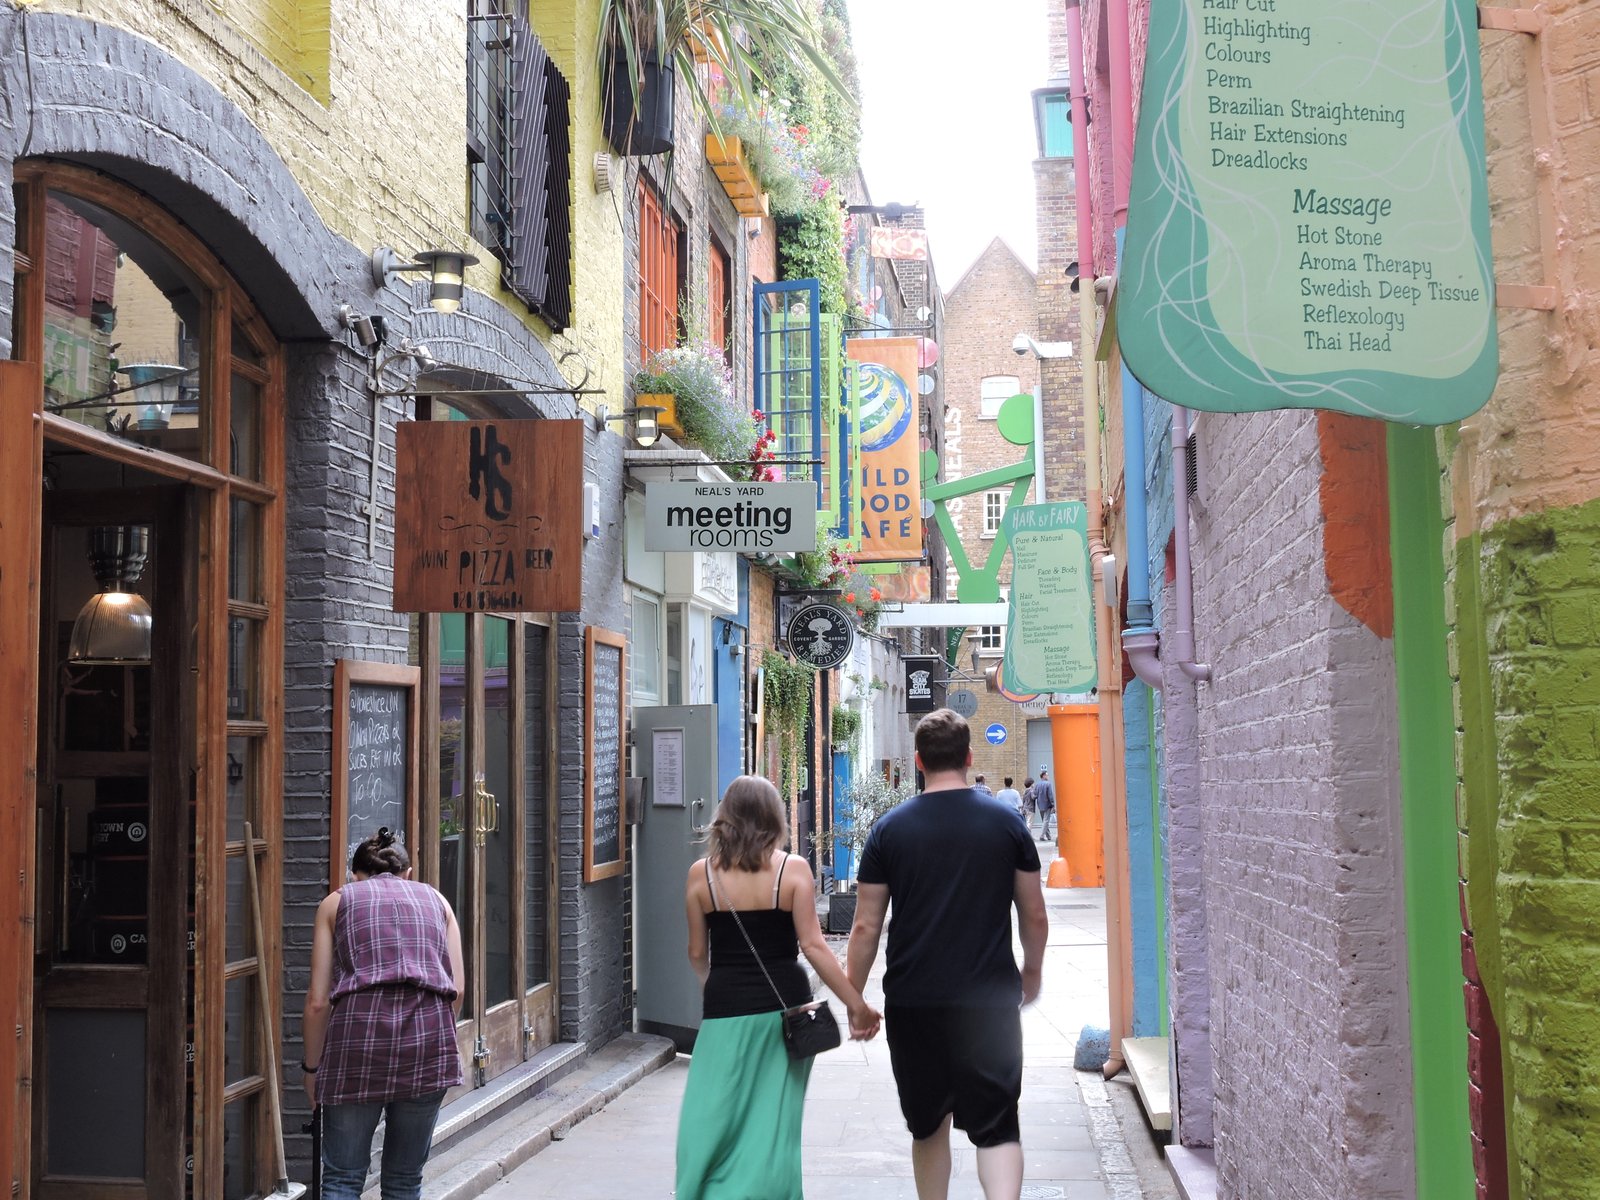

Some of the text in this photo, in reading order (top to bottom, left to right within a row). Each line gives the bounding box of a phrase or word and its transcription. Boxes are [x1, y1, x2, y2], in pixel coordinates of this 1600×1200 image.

[1202, 0, 1276, 12] Hair Cut
[1204, 16, 1310, 46] Highlighting
[1205, 42, 1271, 64] Colours
[1206, 69, 1252, 89] Perm
[1208, 95, 1405, 129] Brazilian Straightening
[1210, 121, 1347, 146] Hair Extensions
[1211, 148, 1308, 171] Dreadlocks
[1293, 189, 1392, 225] Massage
[1297, 224, 1383, 246] Hot Stone
[1299, 251, 1432, 280] Aroma Therapy
[1300, 278, 1479, 306] Swedish Deep Tissue
[1303, 304, 1405, 331] Reflexology
[1304, 331, 1392, 351] Thai Head
[861, 464, 910, 487] ILD
[695, 487, 764, 496] NEAL'S YARD
[667, 501, 792, 535] meeting
[1012, 509, 1036, 530] HAIR
[1050, 506, 1080, 527] FAIRY
[690, 529, 774, 547] rooms
[1015, 537, 1030, 545] Pure
[1040, 533, 1064, 542] Natural
[421, 549, 553, 586] WINE PIZZA BEER
[1037, 565, 1078, 576] Face & Body
[1020, 592, 1033, 600] Hair
[795, 609, 821, 635] NEAL'S
[826, 610, 847, 634] YARD
[797, 644, 845, 664] REMEDIES
[1044, 646, 1070, 654] Massage
[958, 694, 967, 704] 17
